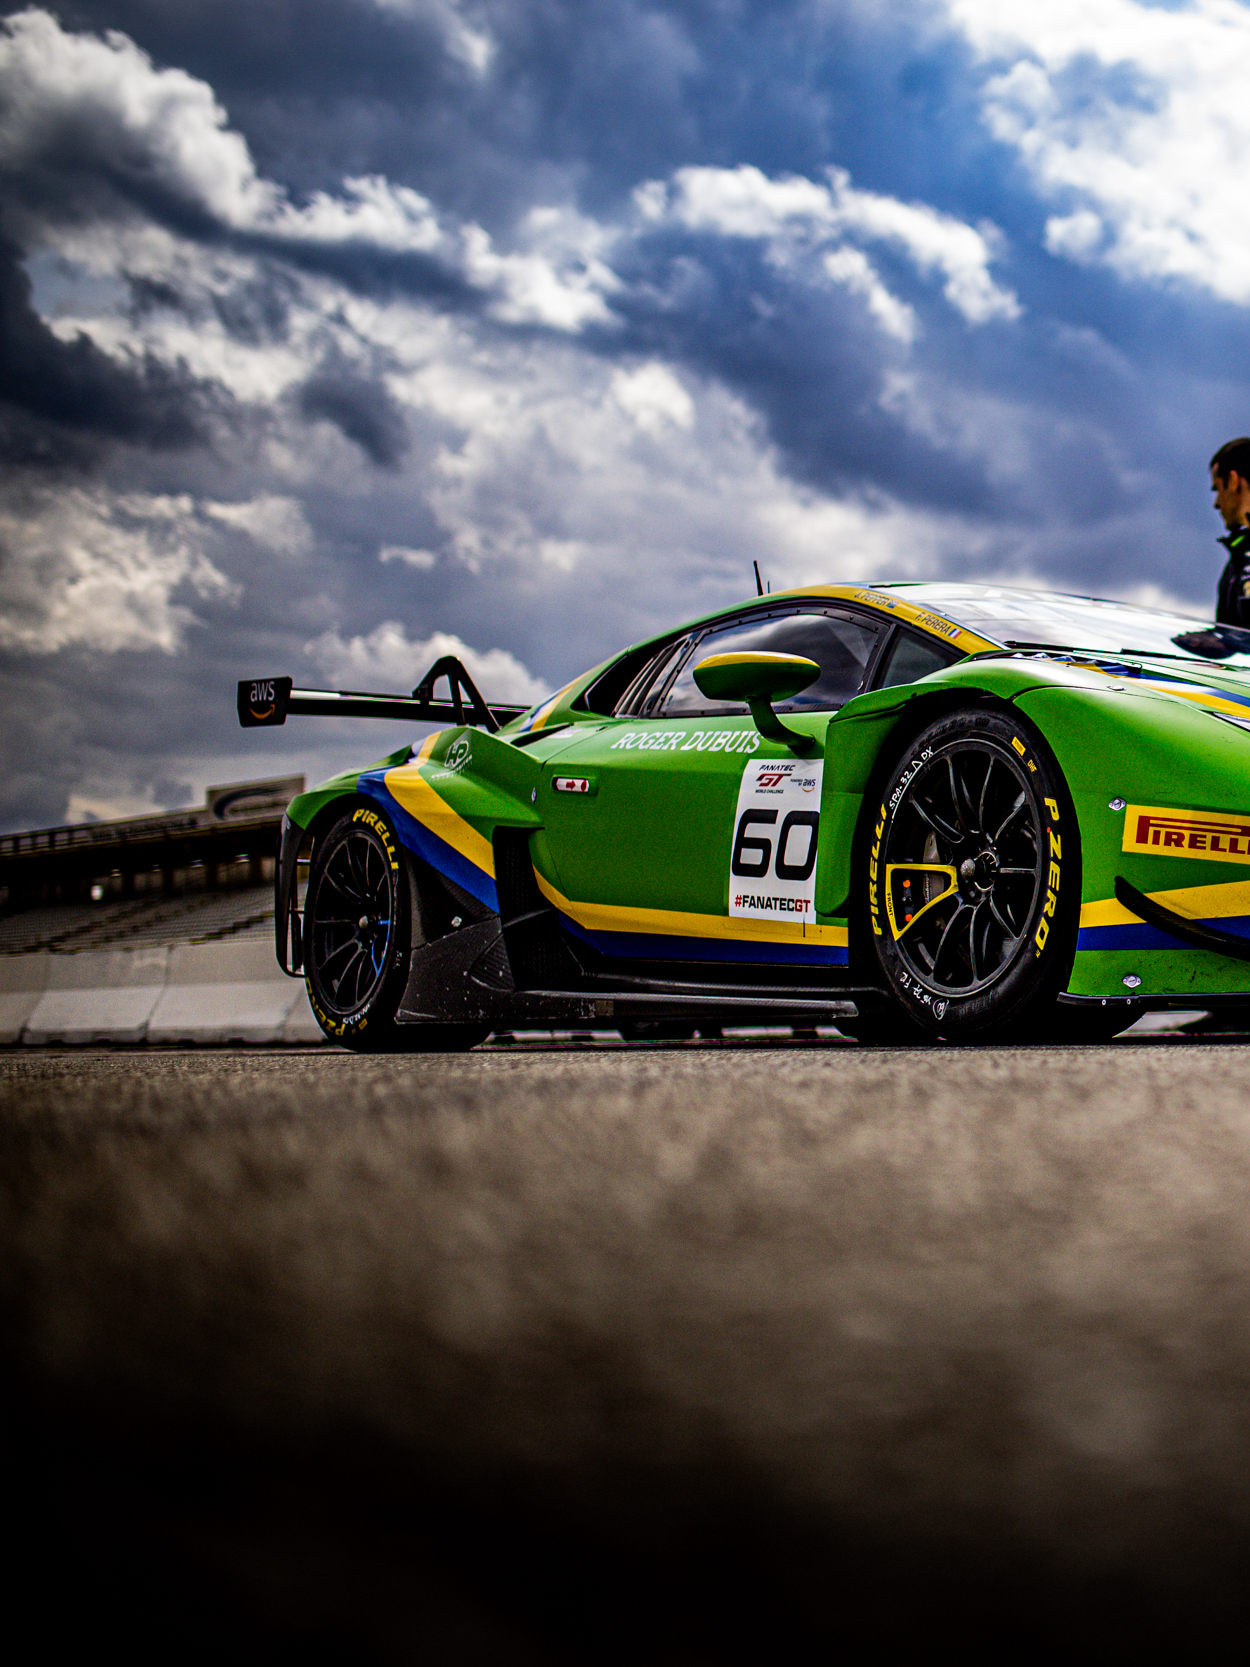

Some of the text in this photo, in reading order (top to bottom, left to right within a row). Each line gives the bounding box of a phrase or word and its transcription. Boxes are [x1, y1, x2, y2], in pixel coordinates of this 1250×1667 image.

[861, 592, 890, 606] PEPPER
[920, 613, 951, 634] PERERA
[250, 681, 275, 702] aws
[611, 731, 763, 753] ROGER DUBUIS
[756, 773, 792, 787] GT
[803, 779, 816, 787] aws
[353, 809, 399, 870] PIRELLI
[731, 808, 820, 881] 60
[869, 803, 887, 936] PIRELLI
[735, 894, 811, 913] #FANATECGT
[886, 892, 894, 917] FRONT
